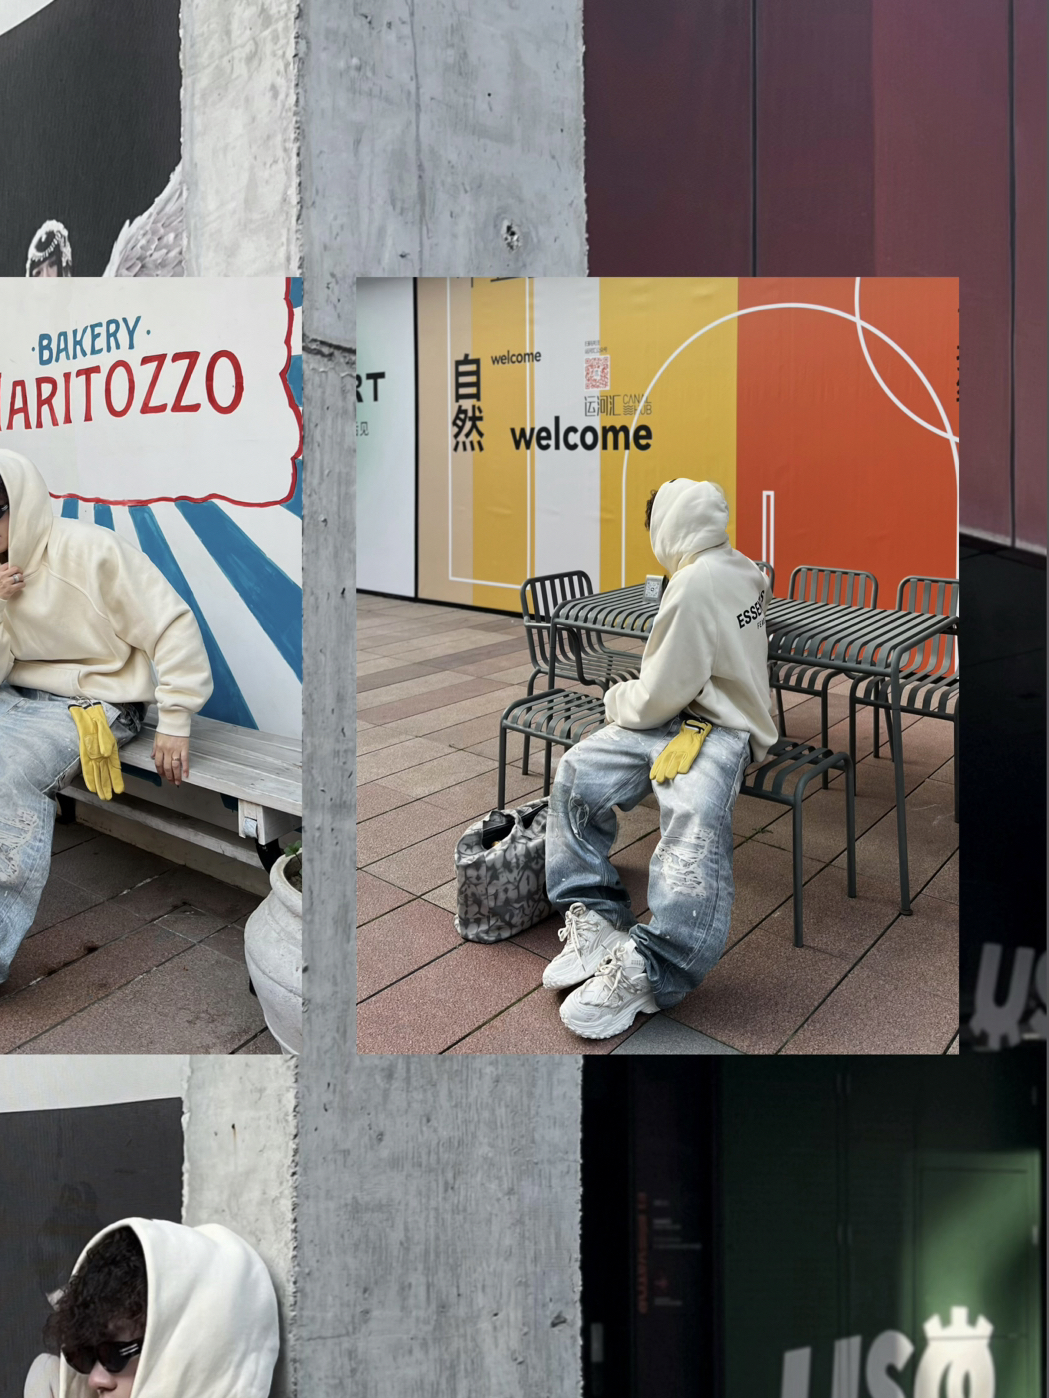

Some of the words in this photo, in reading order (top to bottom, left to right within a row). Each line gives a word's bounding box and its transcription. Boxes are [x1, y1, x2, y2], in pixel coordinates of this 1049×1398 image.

[37, 315, 142, 366] BAKERY
[491, 349, 542, 366] welcome
[451, 352, 485, 453] 自然
[584, 394, 621, 417] 运河汇
[510, 415, 653, 452] welcome
